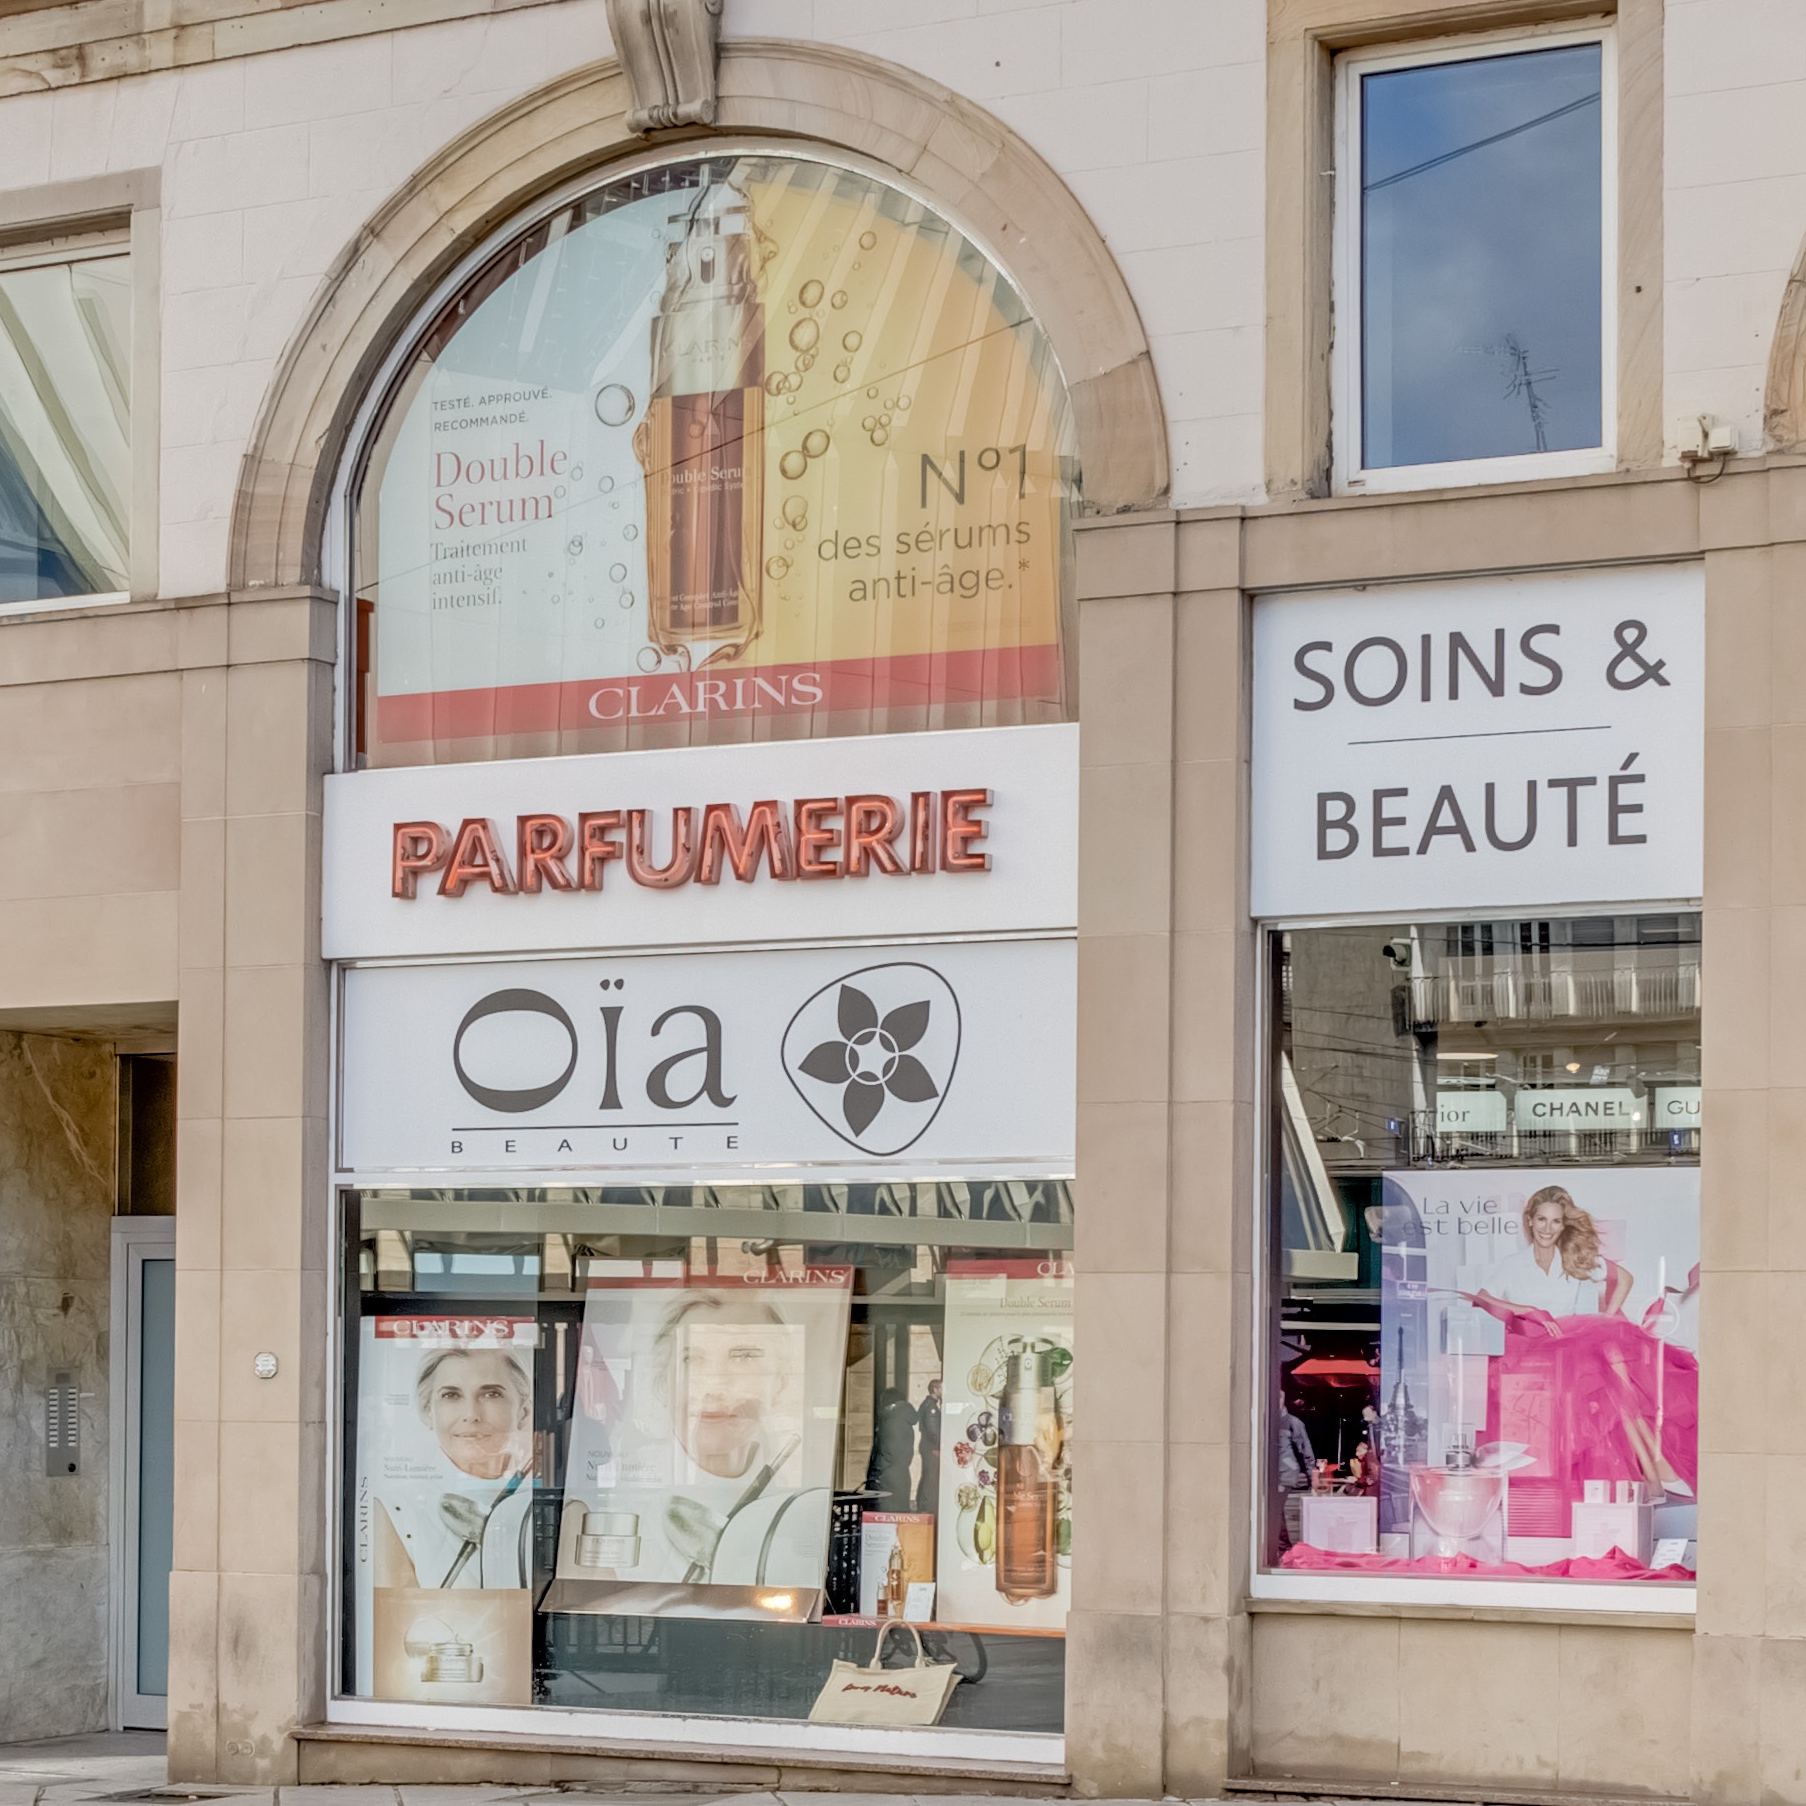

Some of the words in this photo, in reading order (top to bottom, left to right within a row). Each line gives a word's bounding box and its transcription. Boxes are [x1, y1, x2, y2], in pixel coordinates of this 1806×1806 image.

[432, 395, 474, 411] TESTÉ.
[479, 386, 552, 407] APPROUVÉ.
[434, 411, 529, 433] RECOMMANDÉ.
[433, 439, 568, 488] Double
[434, 493, 553, 530] Serum
[430, 538, 527, 561] Traitement
[817, 529, 888, 562] des
[896, 515, 1032, 555] sérums
[432, 564, 503, 585] anti-âge
[432, 586, 502, 610] intensif.
[1293, 623, 1564, 712] SOINS
[1605, 619, 1671, 691] &
[588, 672, 824, 720] CLARINS
[1316, 752, 1648, 861] BEAUTÉ
[392, 788, 993, 899] PARFUMERIE
[453, 978, 739, 1113] Oïa
[1532, 1101, 1630, 1117] CHANEL
[450, 1134, 739, 1155] BEAUTE
[1423, 1197, 1449, 1214] La
[1460, 1196, 1497, 1214] vie
[1403, 1219, 1449, 1235] est
[1458, 1217, 1518, 1235] belle
[744, 1269, 845, 1285] CLARINS
[1000, 1296, 1036, 1309] Double
[1038, 1296, 1071, 1309] Serum
[394, 1319, 509, 1337] CLARINS
[360, 1475, 369, 1563] CLARINS
[875, 1514, 920, 1523] CLARINS
[838, 1618, 877, 1627] CLARINS
